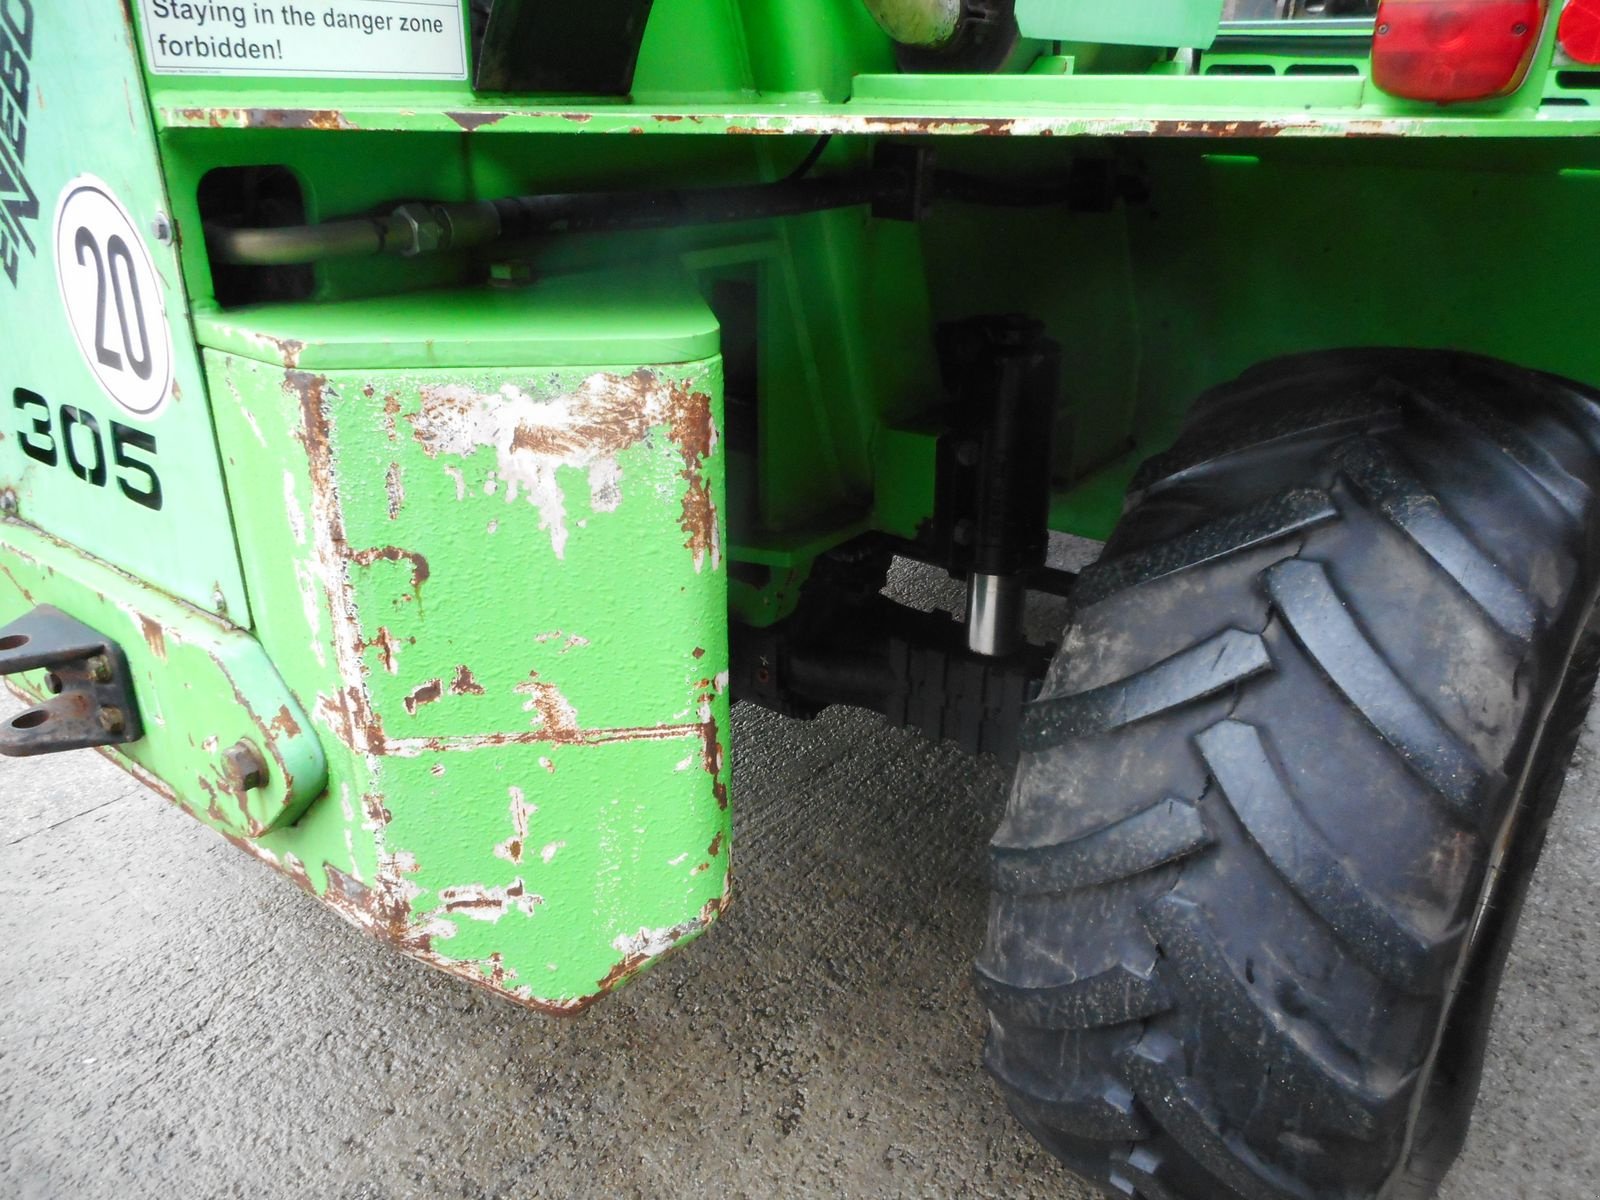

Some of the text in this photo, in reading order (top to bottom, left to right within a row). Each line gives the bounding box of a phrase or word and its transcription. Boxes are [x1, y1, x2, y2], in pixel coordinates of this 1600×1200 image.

[153, 0, 444, 35] Staying in the danger zone
[158, 33, 283, 60] forbidden!
[75, 225, 153, 381] 20
[13, 387, 163, 511] 305
